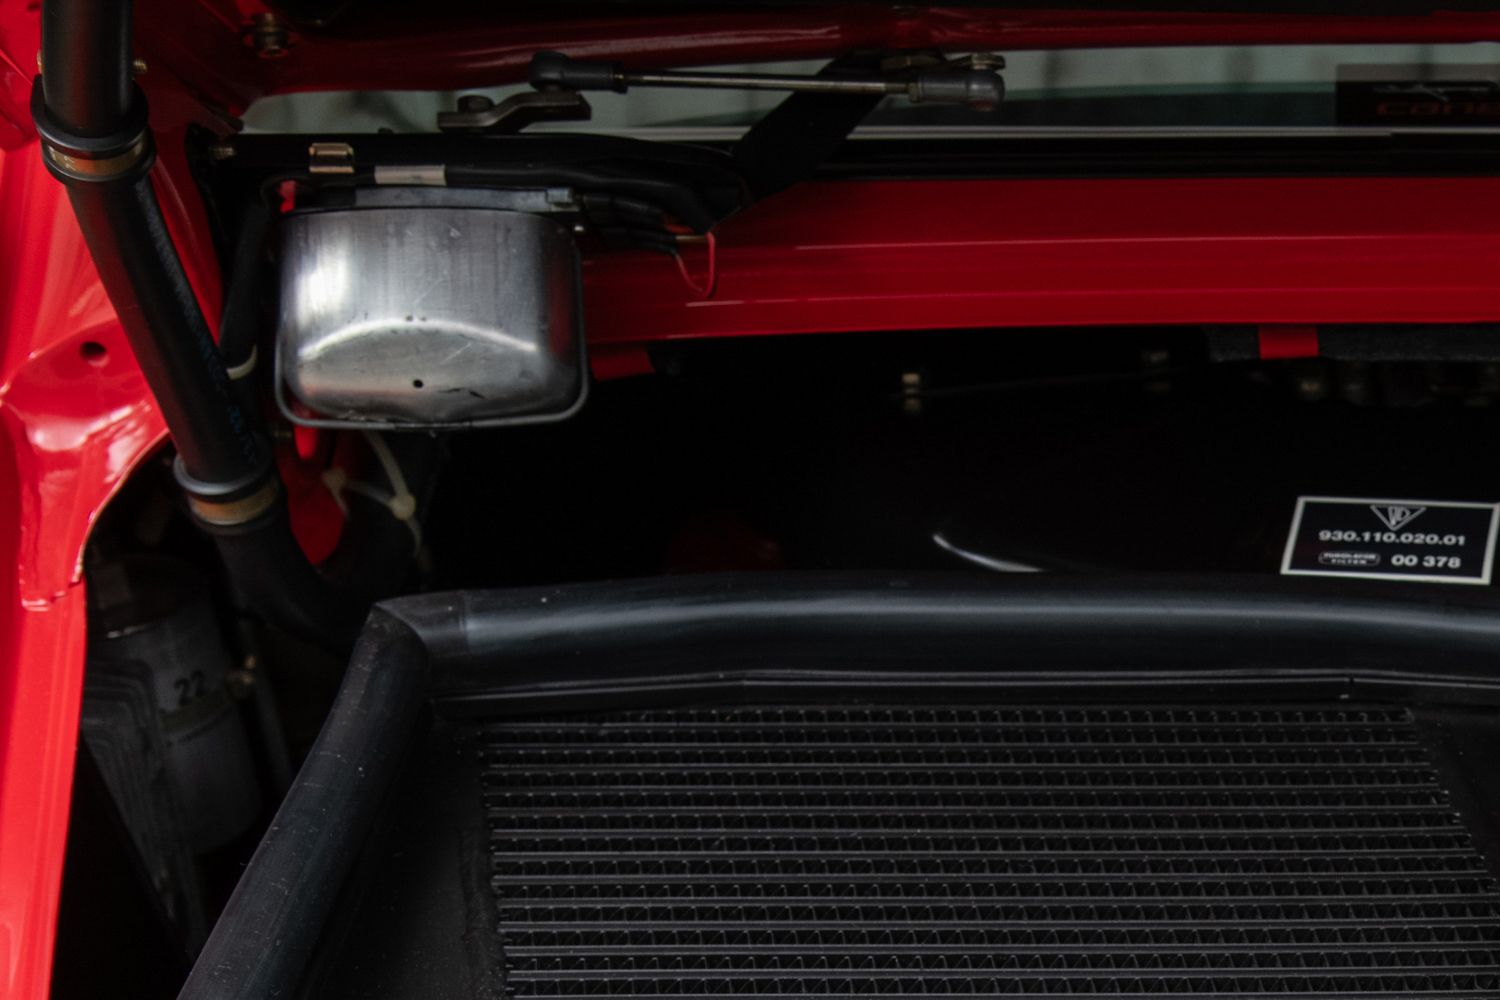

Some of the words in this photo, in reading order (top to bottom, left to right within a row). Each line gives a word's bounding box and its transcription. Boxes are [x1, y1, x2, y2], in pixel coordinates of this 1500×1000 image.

[1319, 530, 1465, 545] 930.110.020.01
[1391, 555, 1418, 566] 00
[1423, 555, 1461, 568] 378
[174, 669, 205, 705] 22
